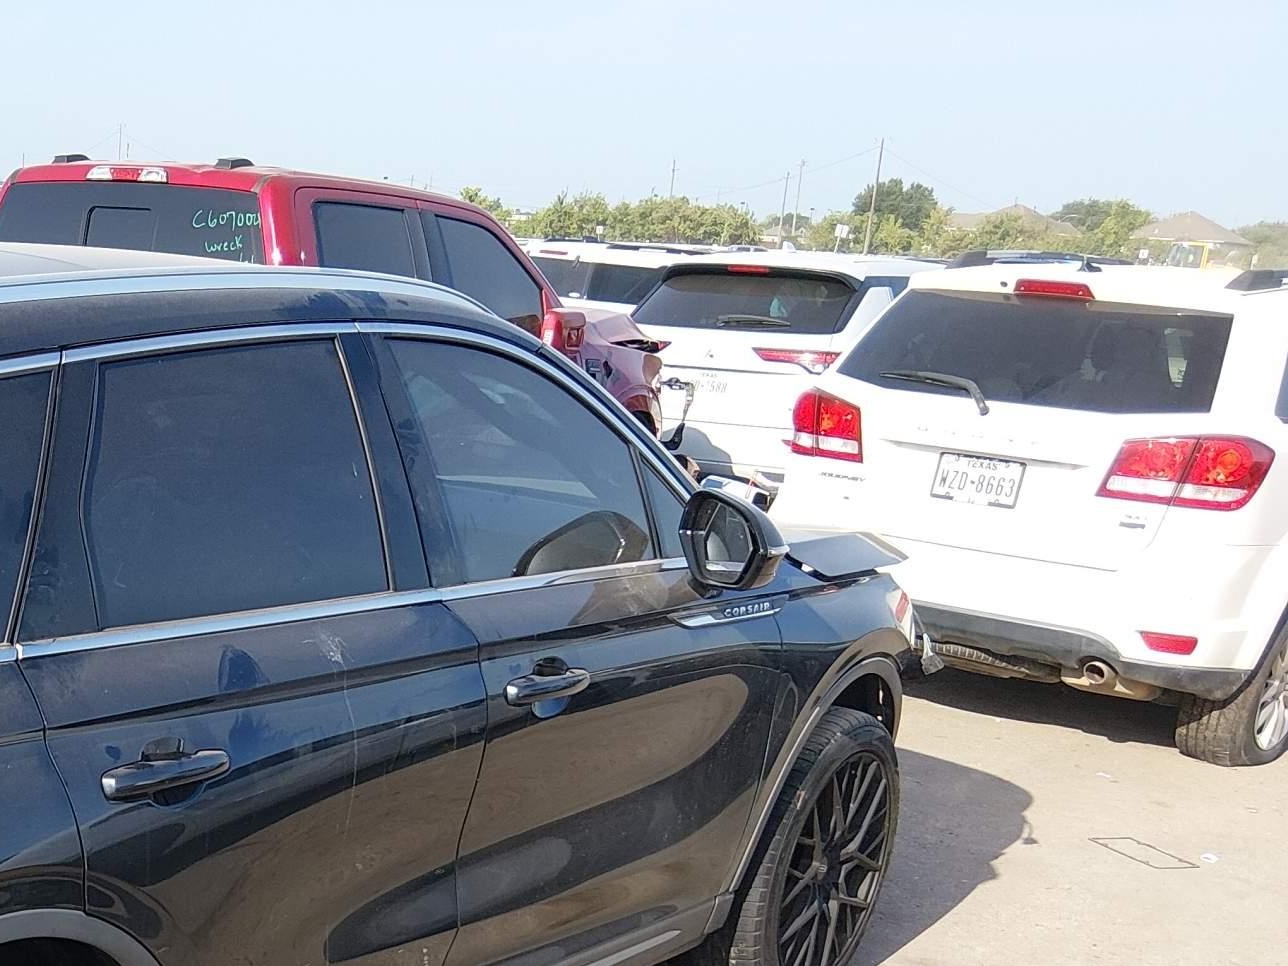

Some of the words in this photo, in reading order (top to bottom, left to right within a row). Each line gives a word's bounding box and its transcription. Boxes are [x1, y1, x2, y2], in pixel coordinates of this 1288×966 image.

[205, 235, 242, 252] wreck
[967, 460, 999, 471] TEXAS
[724, 602, 770, 617] CORSAIR
